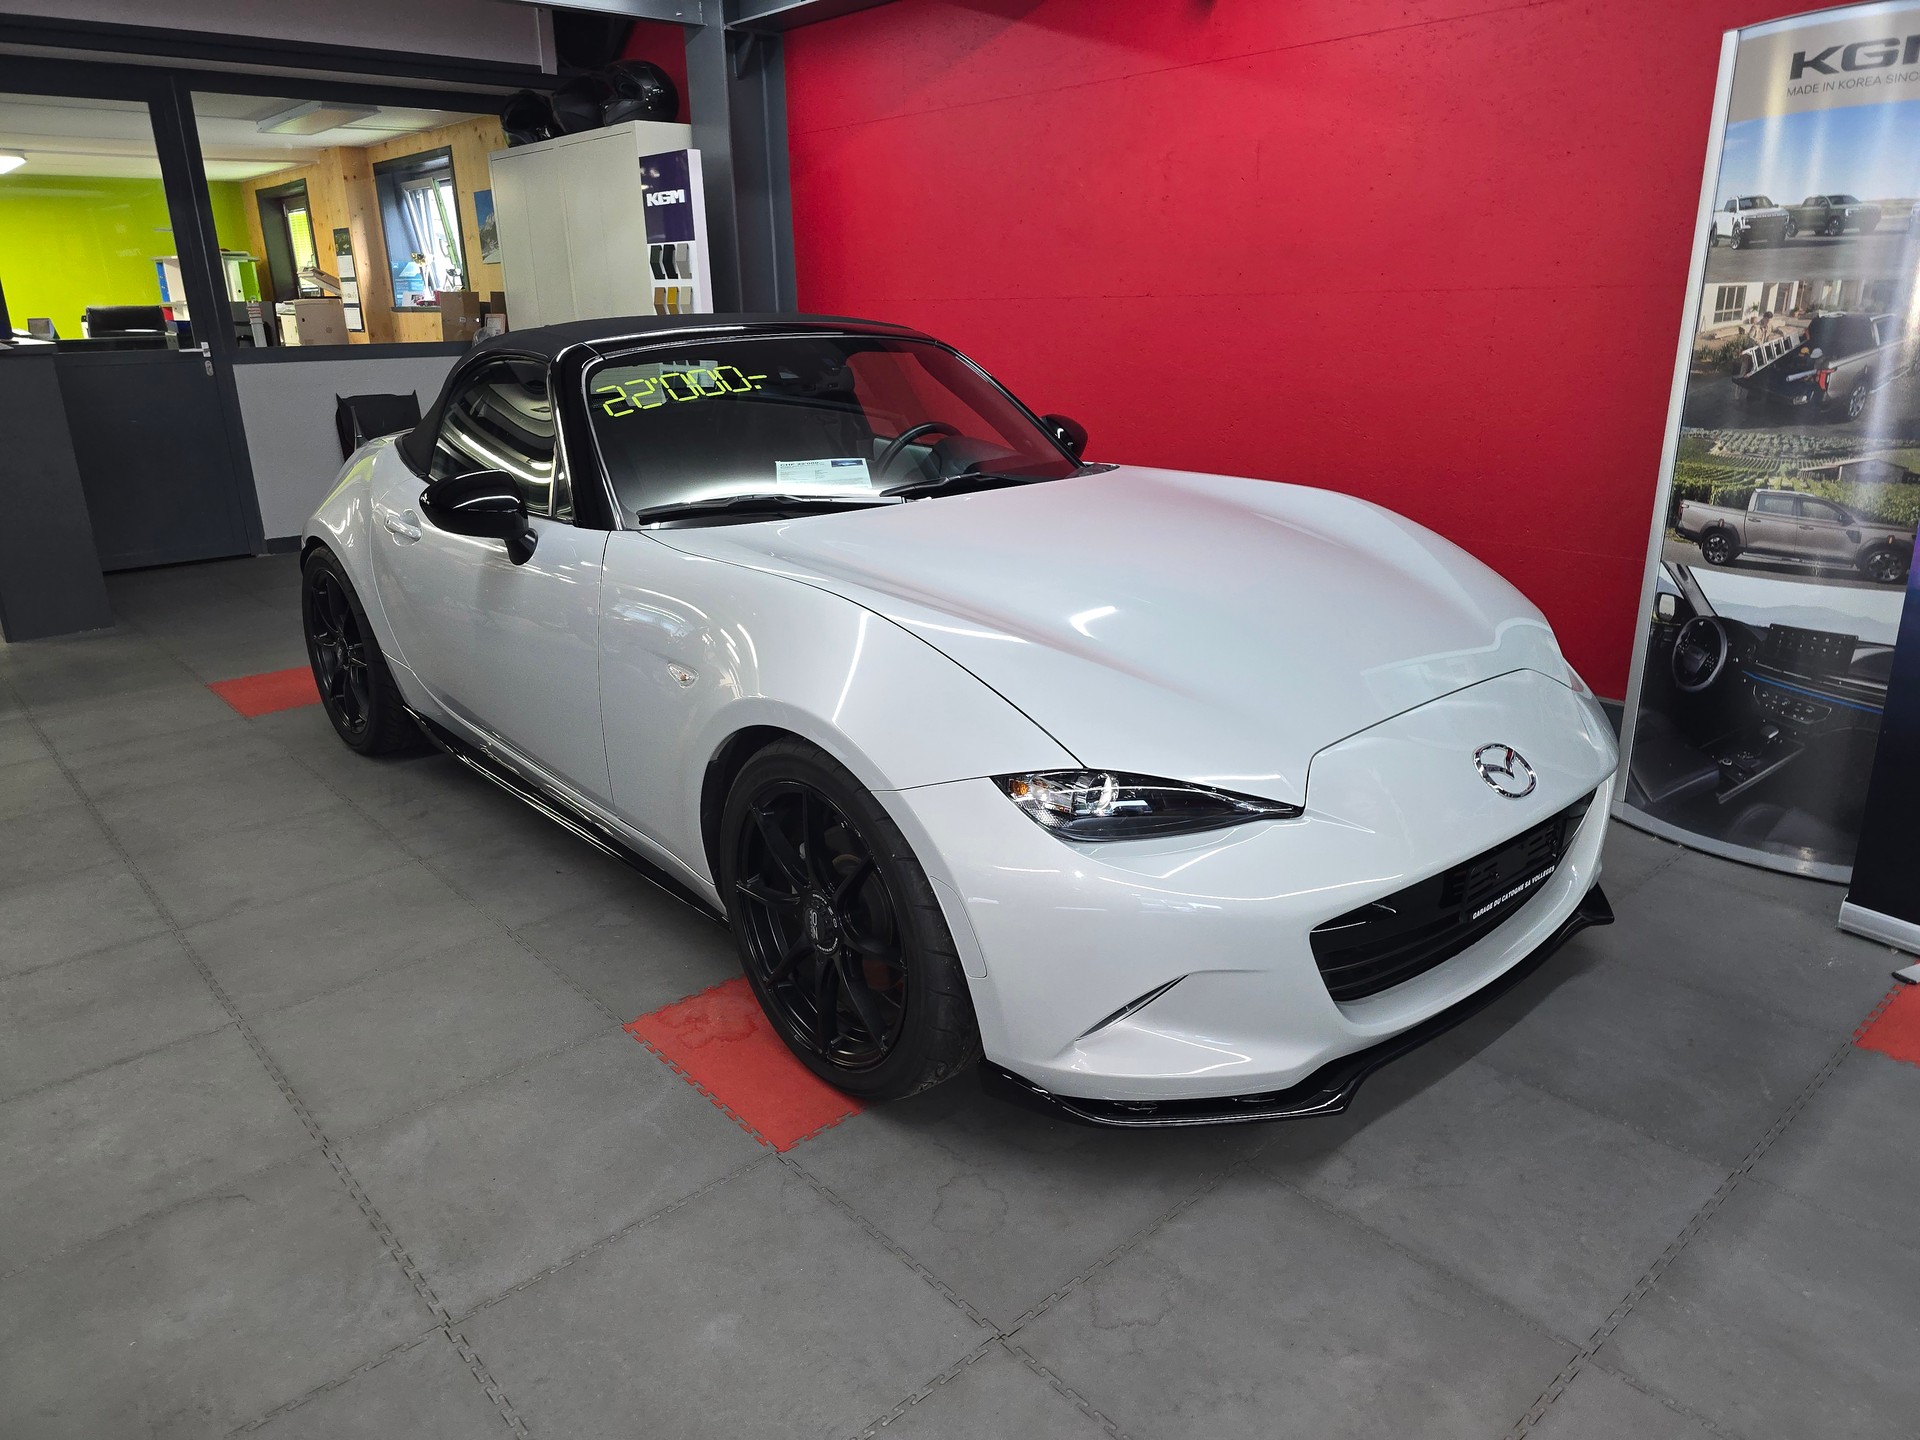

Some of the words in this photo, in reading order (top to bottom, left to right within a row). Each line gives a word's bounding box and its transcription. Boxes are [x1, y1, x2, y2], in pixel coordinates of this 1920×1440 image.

[1787, 83, 1819, 96] MADE
[1823, 81, 1835, 92] IN
[1838, 75, 1882, 90] KOREA
[1886, 71, 1920, 84] SINC
[646, 189, 685, 207] KGM
[1472, 902, 1493, 920] GARAGE
[1493, 897, 1501, 907] DU
[1501, 883, 1524, 902] CATOGNE
[1524, 880, 1531, 889] SA
